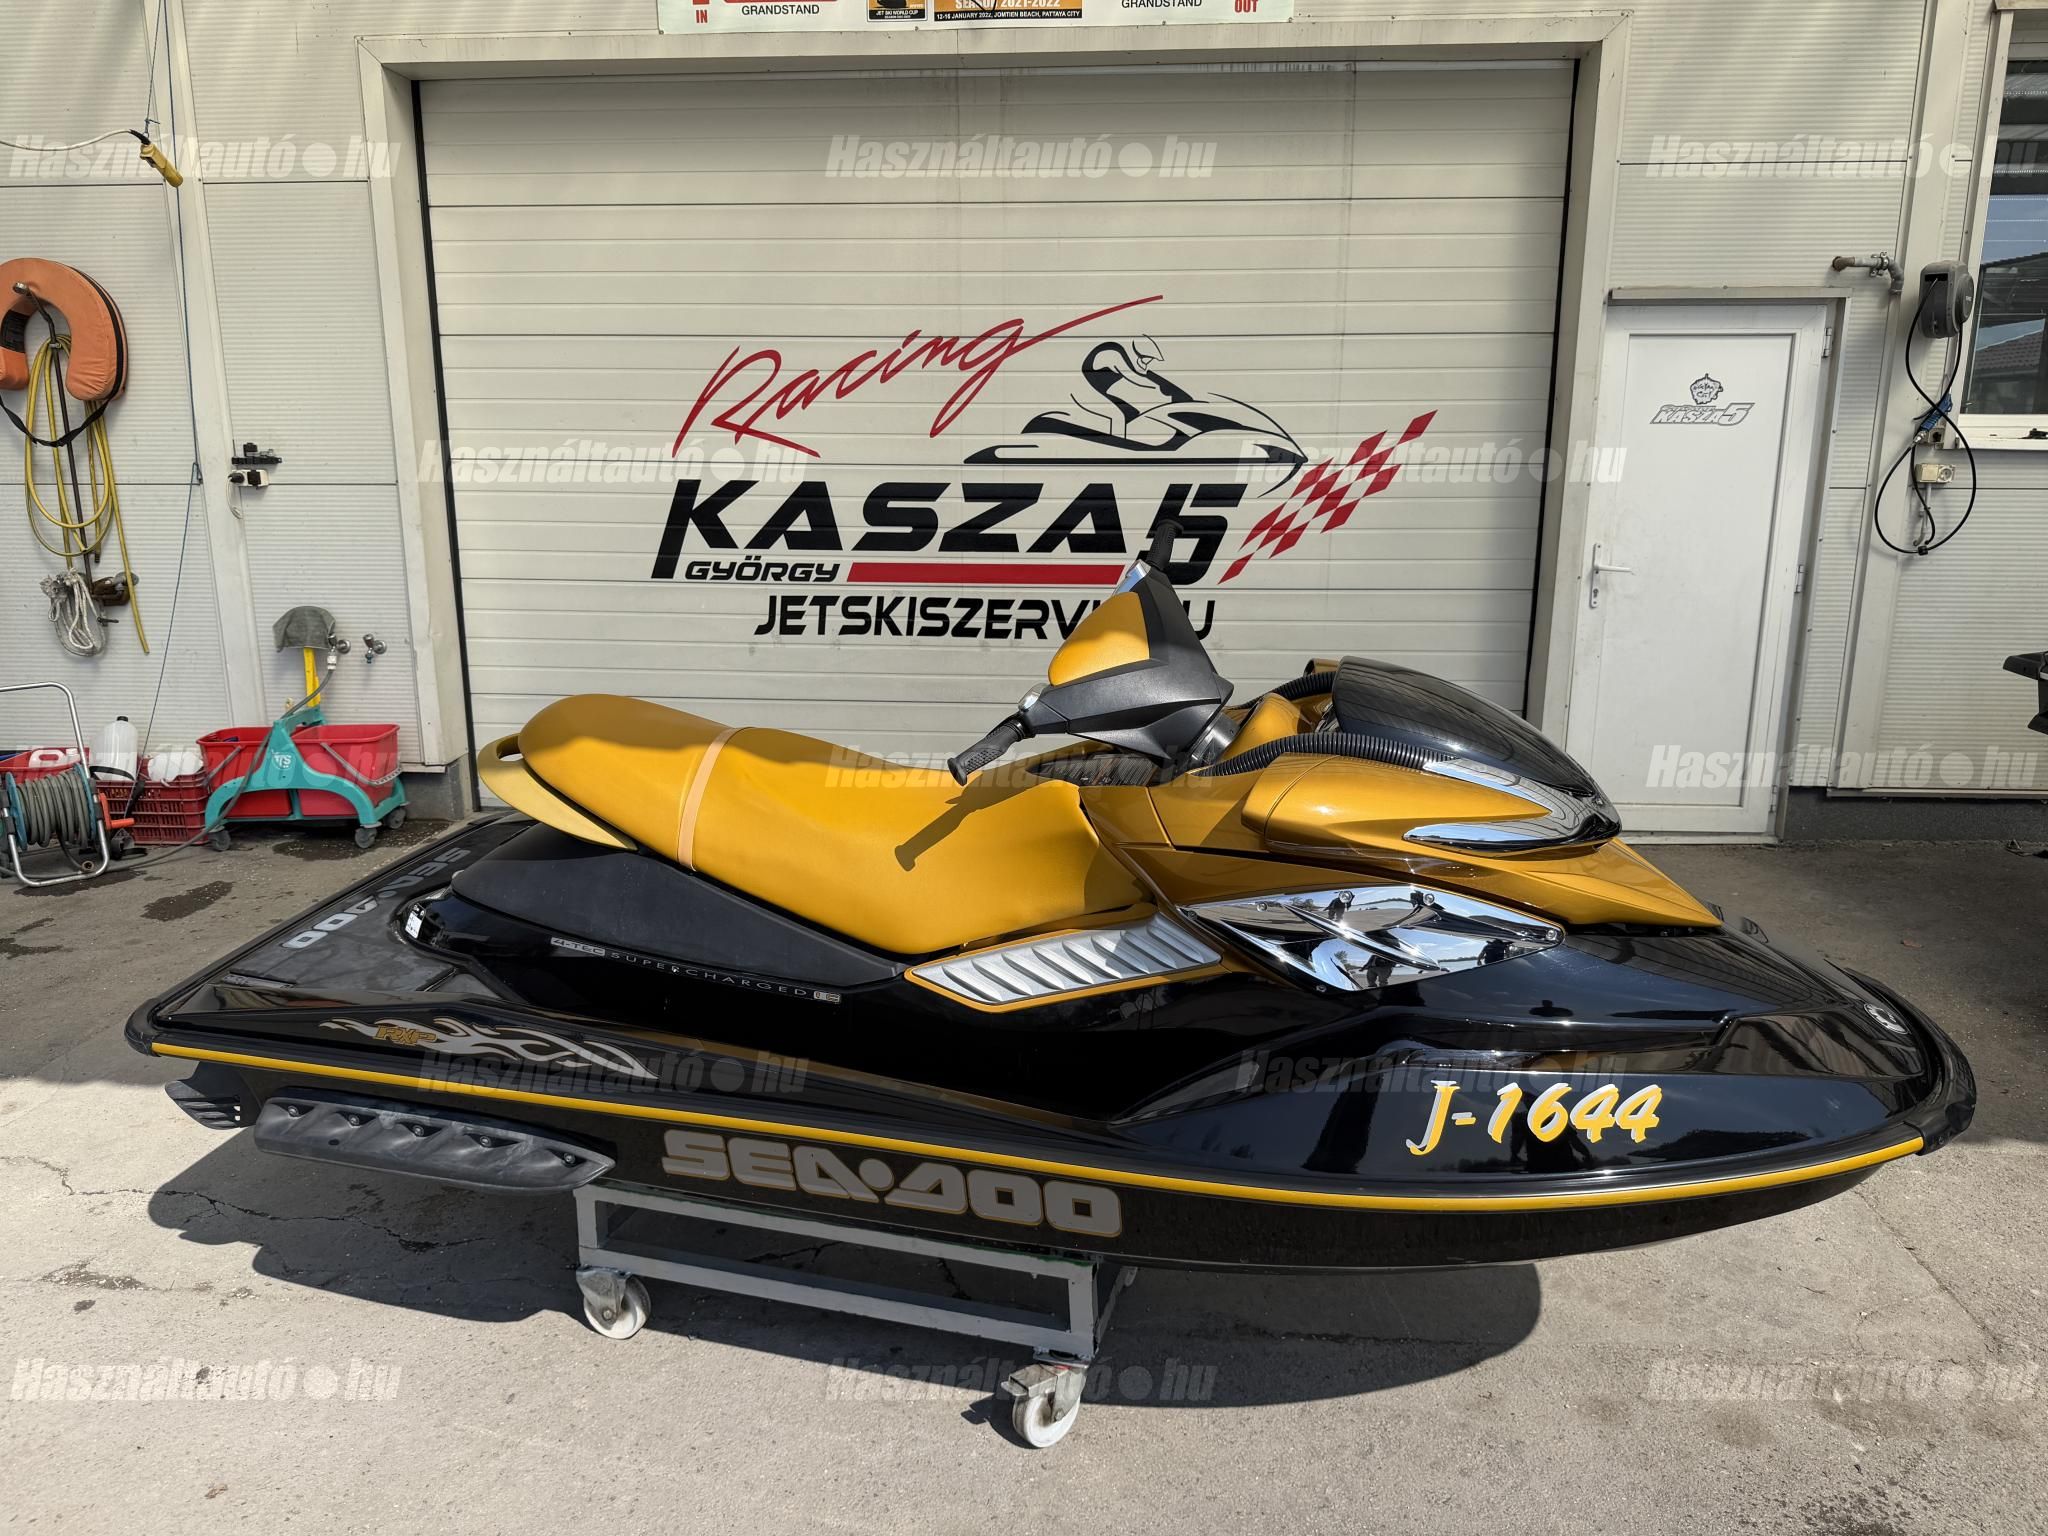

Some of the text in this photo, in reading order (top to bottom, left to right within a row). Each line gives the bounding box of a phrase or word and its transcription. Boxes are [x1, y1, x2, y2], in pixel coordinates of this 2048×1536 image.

[696, 10, 708, 23] IN
[742, 5, 820, 15] GRANDSTAND
[1121, 0, 1202, 8] GRANDSTAND
[1234, 0, 1258, 12] OUT
[672, 295, 1163, 459] Racing
[684, 555, 840, 582] GYÖRGY
[754, 595, 1215, 640] JETSKISZERVU
[611, 952, 807, 996] SUPERCHARGED
[1405, 1080, 1663, 1156] J-1644
